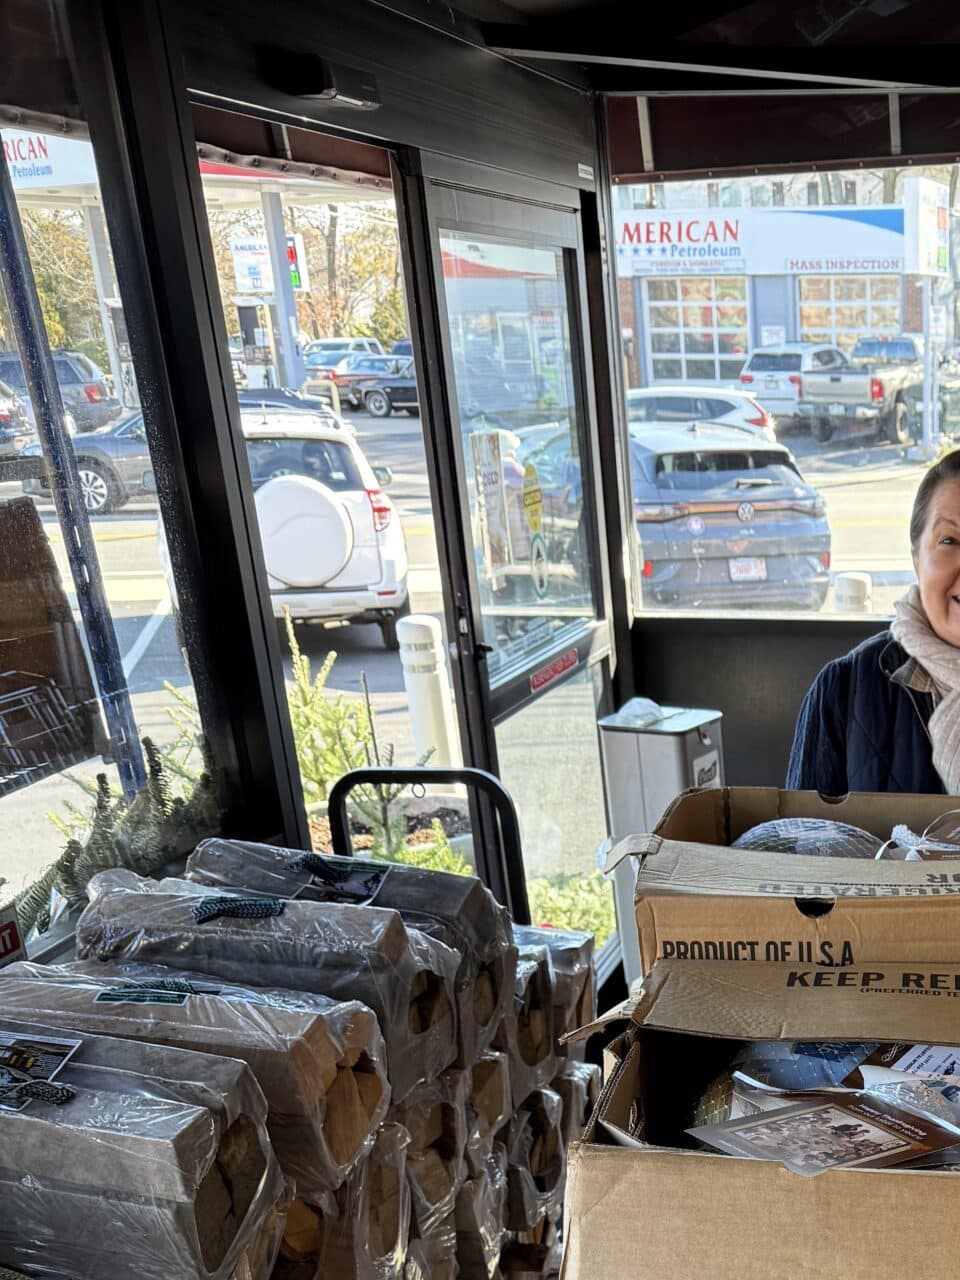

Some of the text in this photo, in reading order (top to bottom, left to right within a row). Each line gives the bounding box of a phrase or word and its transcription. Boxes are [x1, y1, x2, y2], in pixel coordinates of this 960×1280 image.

[617, 219, 740, 245] MERICAN
[671, 243, 741, 258] Petroleum
[790, 259, 899, 271] MASS INSPECTION
[662, 940, 759, 961] PRODUCT
[765, 940, 792, 962] OF
[786, 971, 885, 988] KEEP
[860, 987, 942, 996] (PREFERRED
